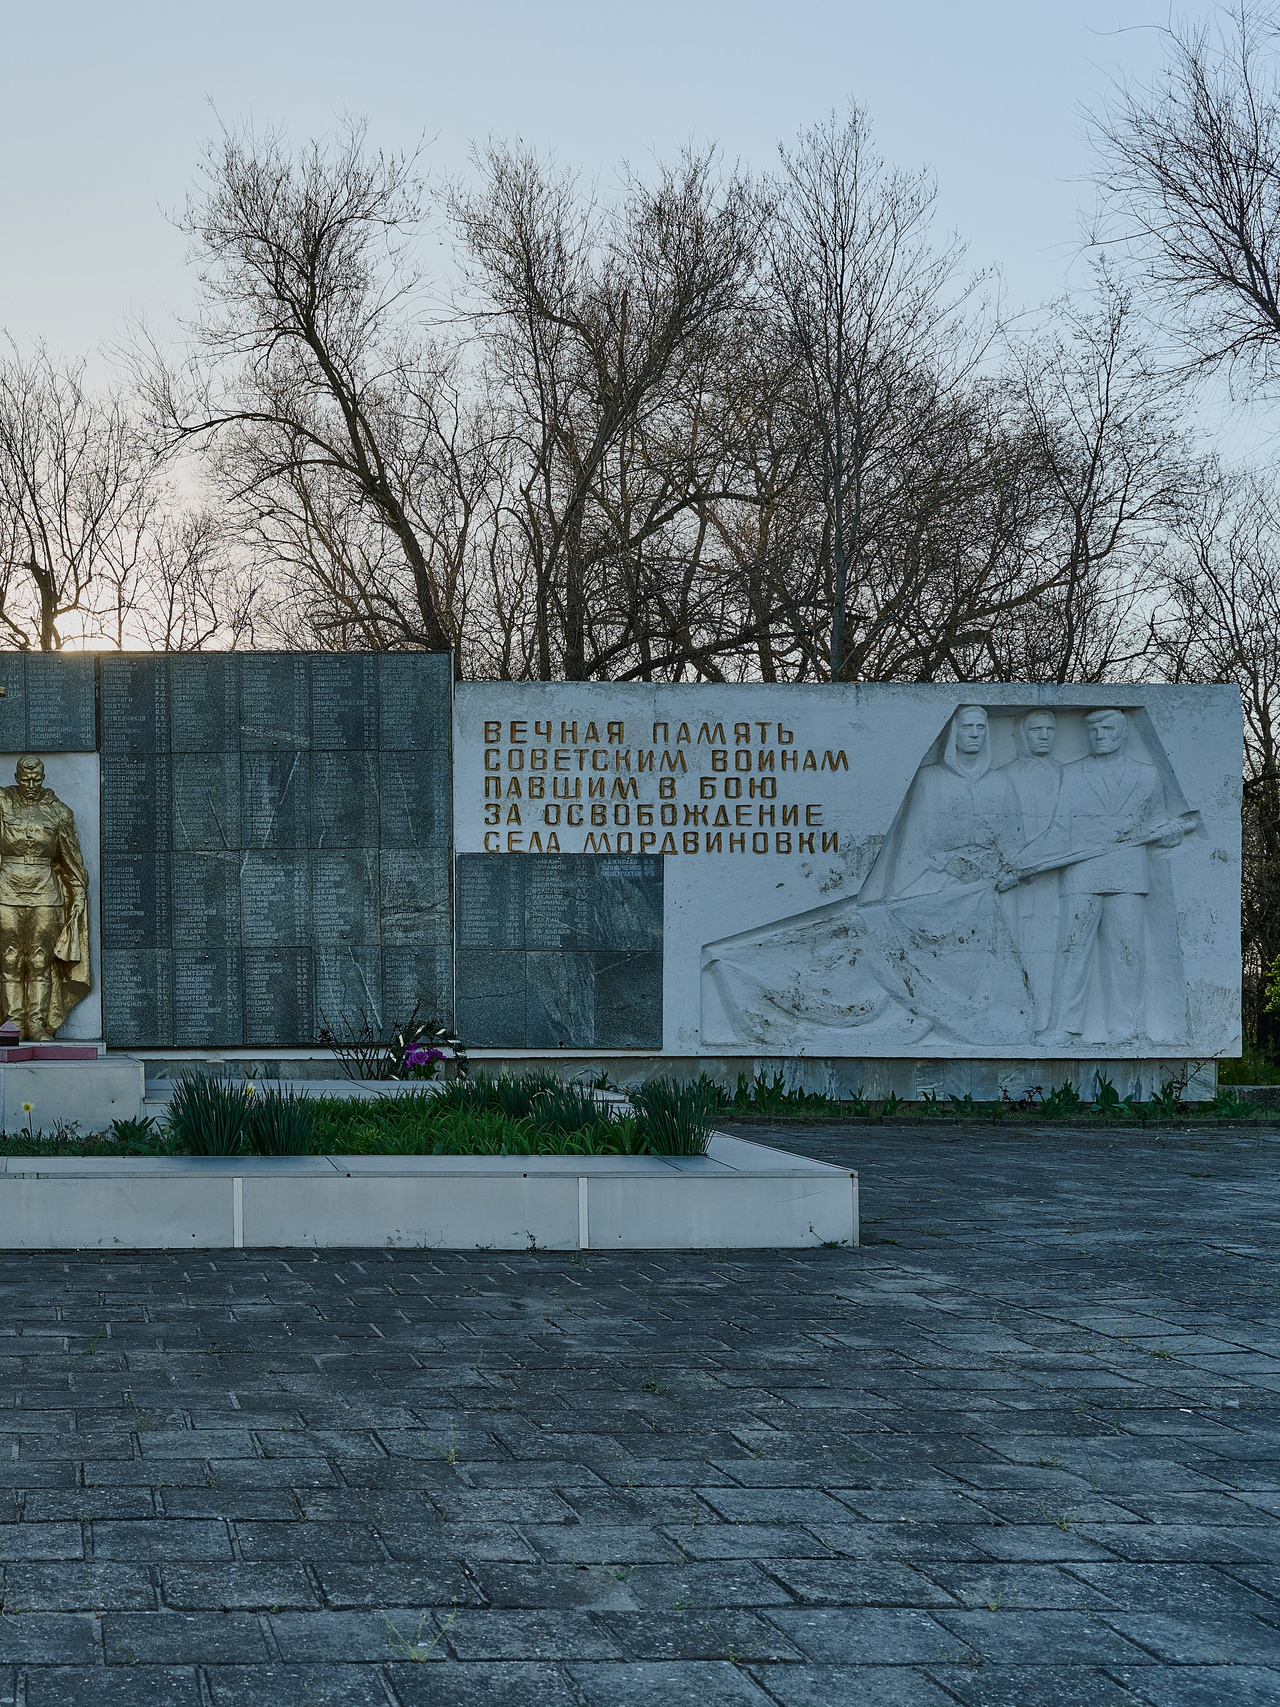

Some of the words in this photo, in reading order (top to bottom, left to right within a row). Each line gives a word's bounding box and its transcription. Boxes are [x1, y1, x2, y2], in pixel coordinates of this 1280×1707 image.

[485, 721, 626, 746] ВЕЧНАЯ
[653, 722, 795, 746] ПАМЯТЬ
[485, 749, 689, 774] СОВЕТСКИМ
[712, 750, 850, 774] ВОИНАМ
[485, 776, 640, 801] ПАВШИМ
[660, 777, 678, 801] В
[701, 777, 778, 801] БОЮ
[485, 804, 523, 827] ЗА
[545, 804, 824, 829] ОСВОБОЖДЕНИЕ
[484, 832, 562, 854] СЕЛА
[584, 832, 840, 855] МОРДВИНОВКИ
